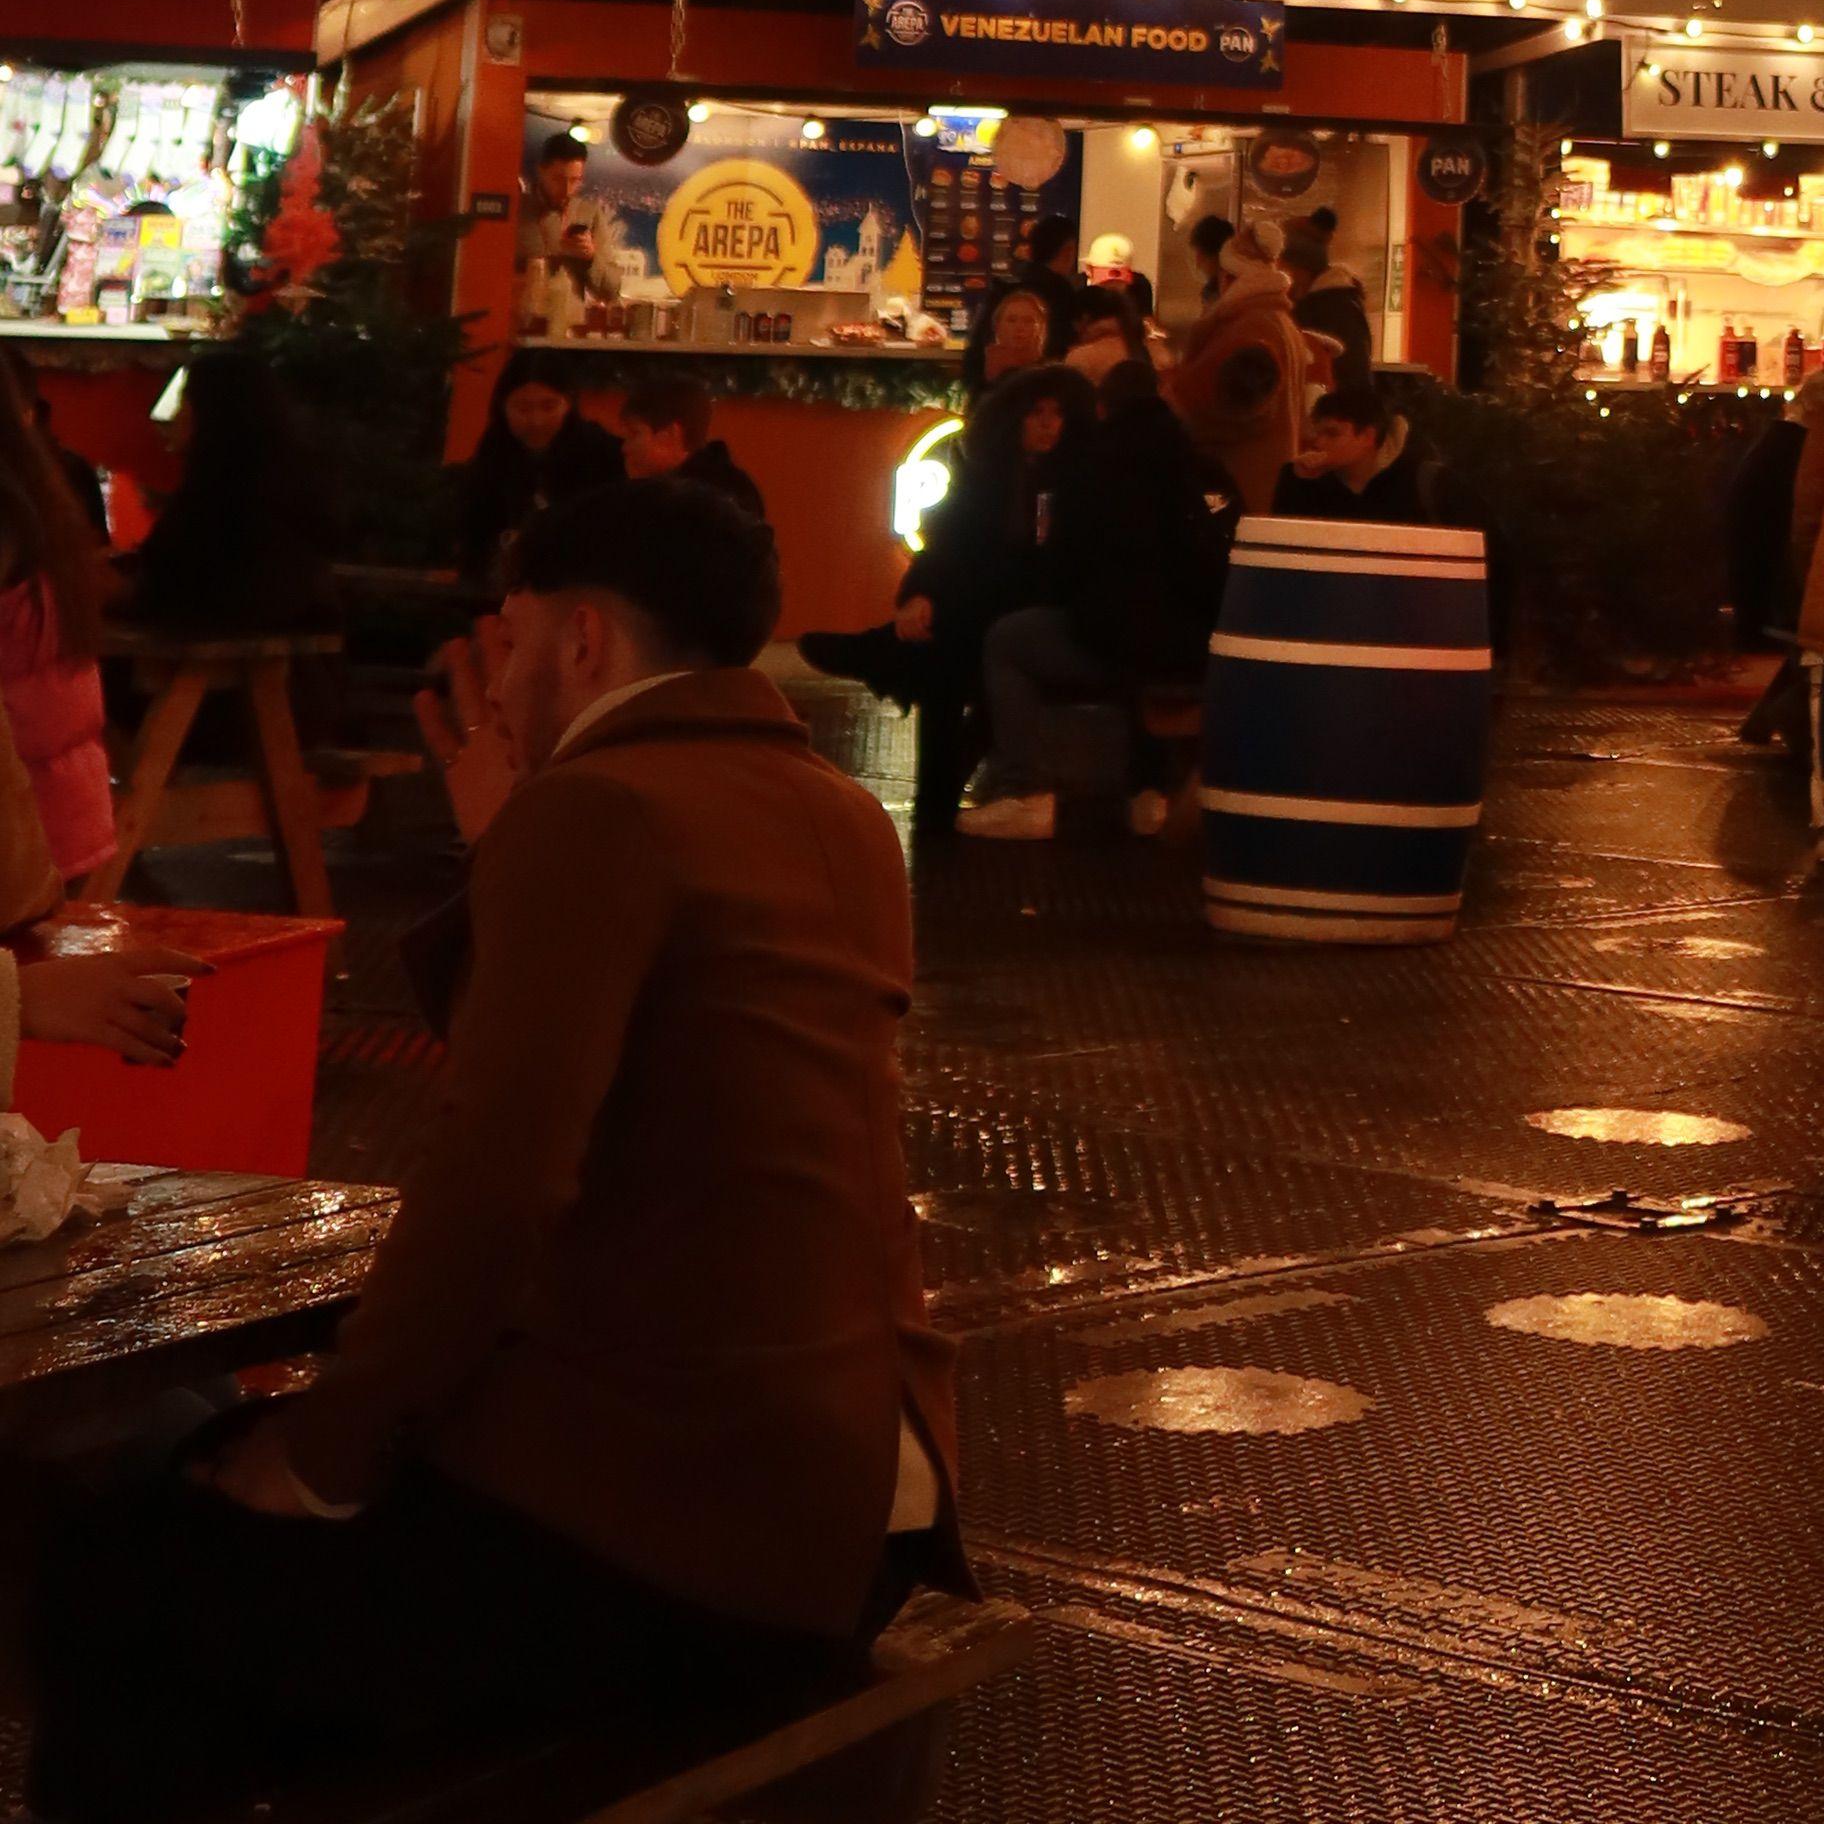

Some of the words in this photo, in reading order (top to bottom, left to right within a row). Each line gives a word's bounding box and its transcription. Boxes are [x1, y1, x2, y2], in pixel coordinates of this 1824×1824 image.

[940, 14, 1123, 48] VENEZUELAN
[1130, 27, 1208, 52] FOOD
[1219, 34, 1255, 54] PAN
[1659, 69, 1799, 113] STEAK
[1431, 157, 1471, 176] PAN
[727, 201, 755, 221] THE
[692, 224, 781, 260] AREPA
